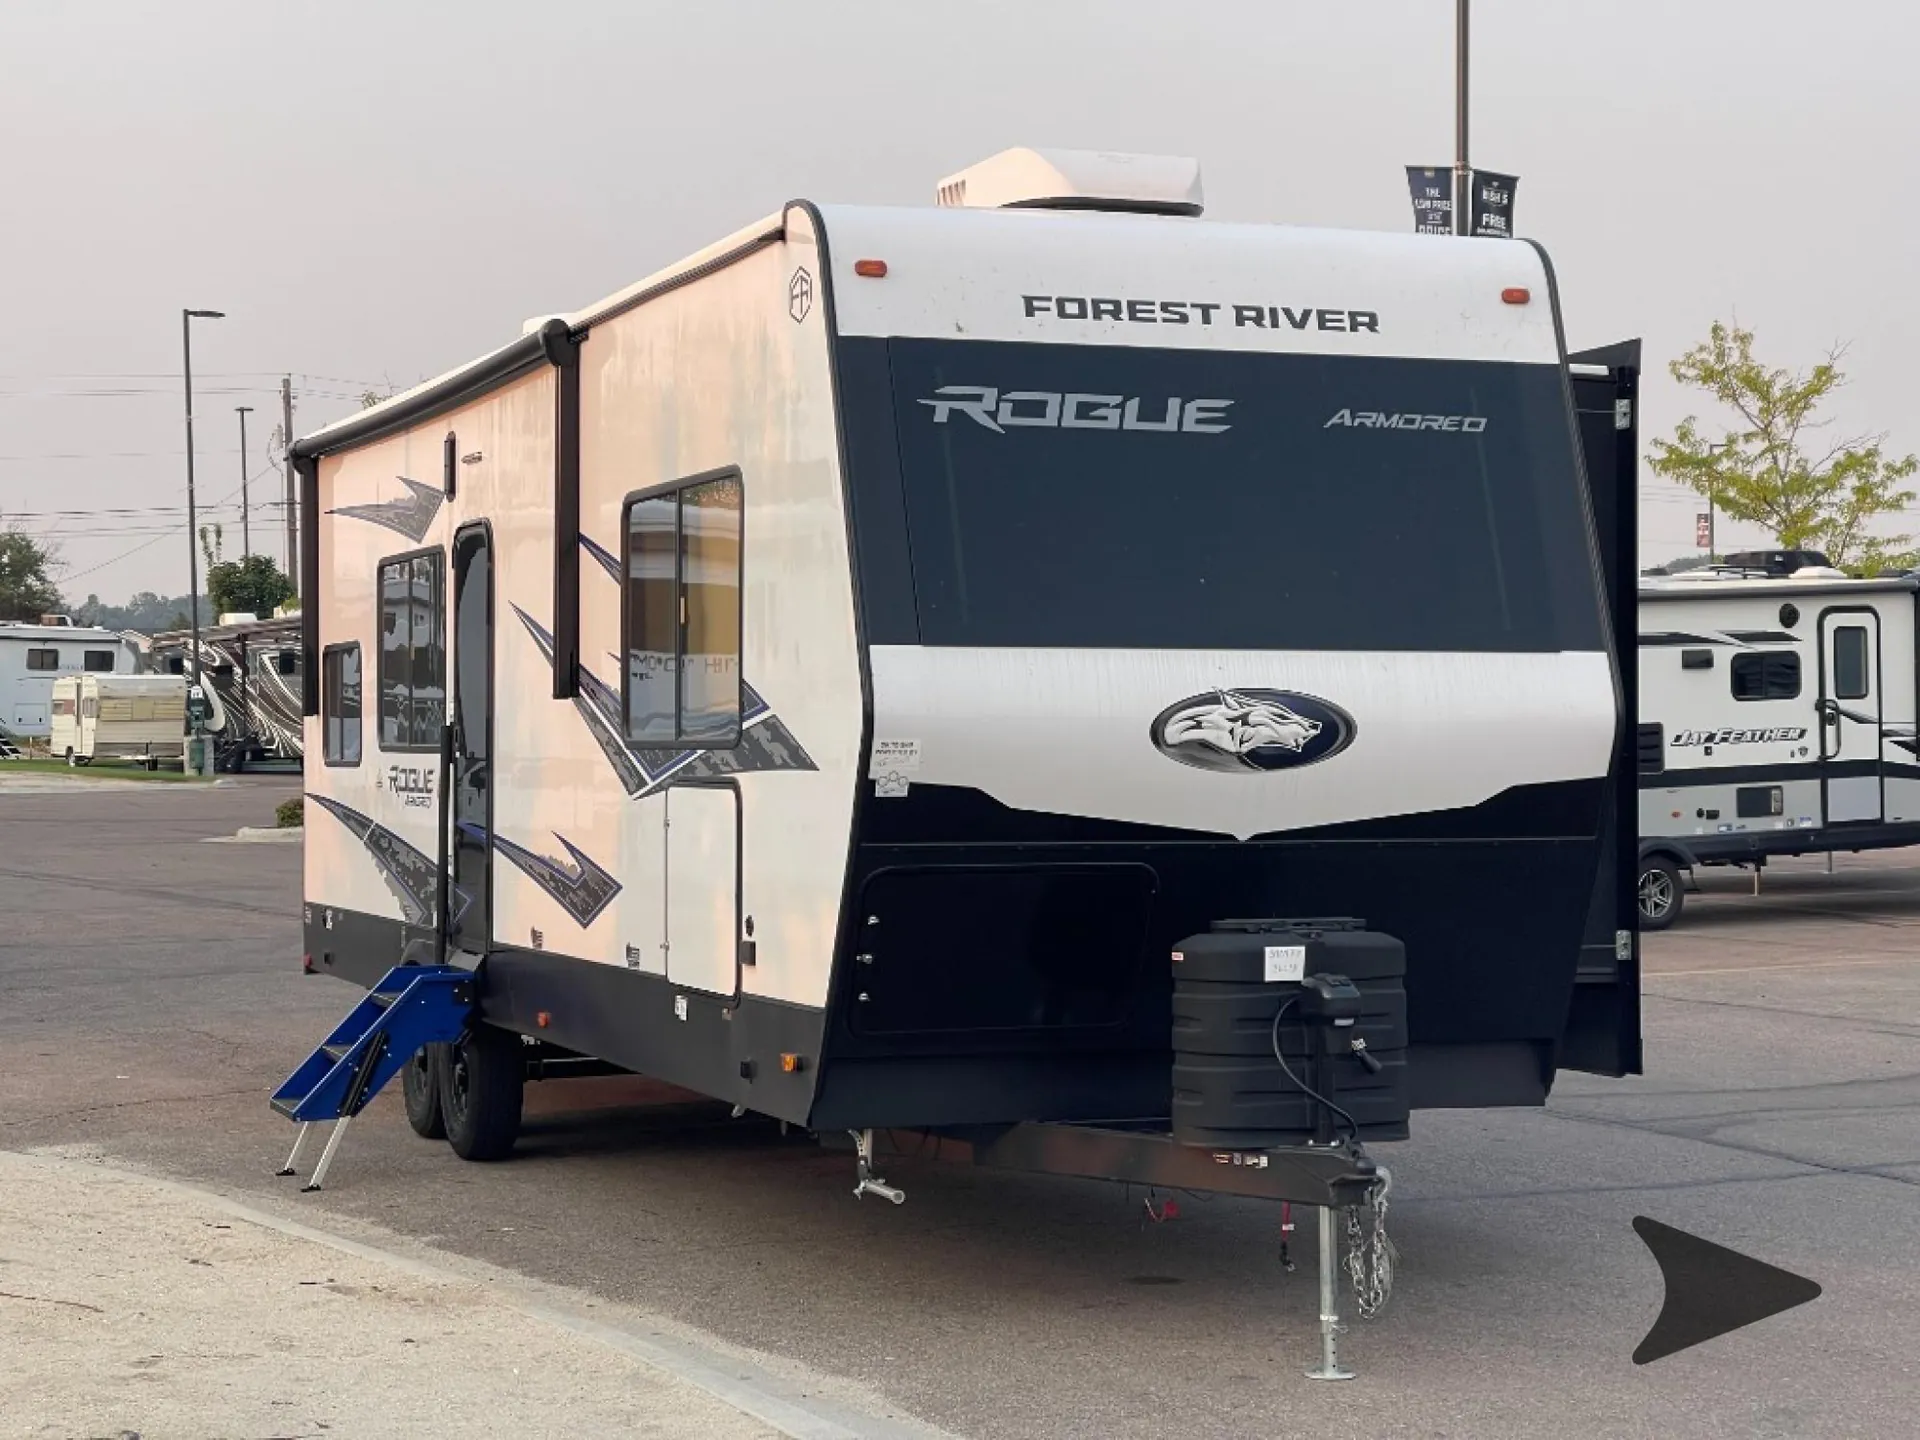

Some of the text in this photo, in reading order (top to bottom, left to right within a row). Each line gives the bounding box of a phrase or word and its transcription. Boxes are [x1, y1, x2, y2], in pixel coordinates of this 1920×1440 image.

[1482, 213, 1506, 230] FREE
[1021, 294, 1380, 334] FOREST RIVER
[916, 385, 1235, 434] ROGUE
[1670, 729, 1713, 747] JAY
[388, 765, 435, 797] ROGUE
